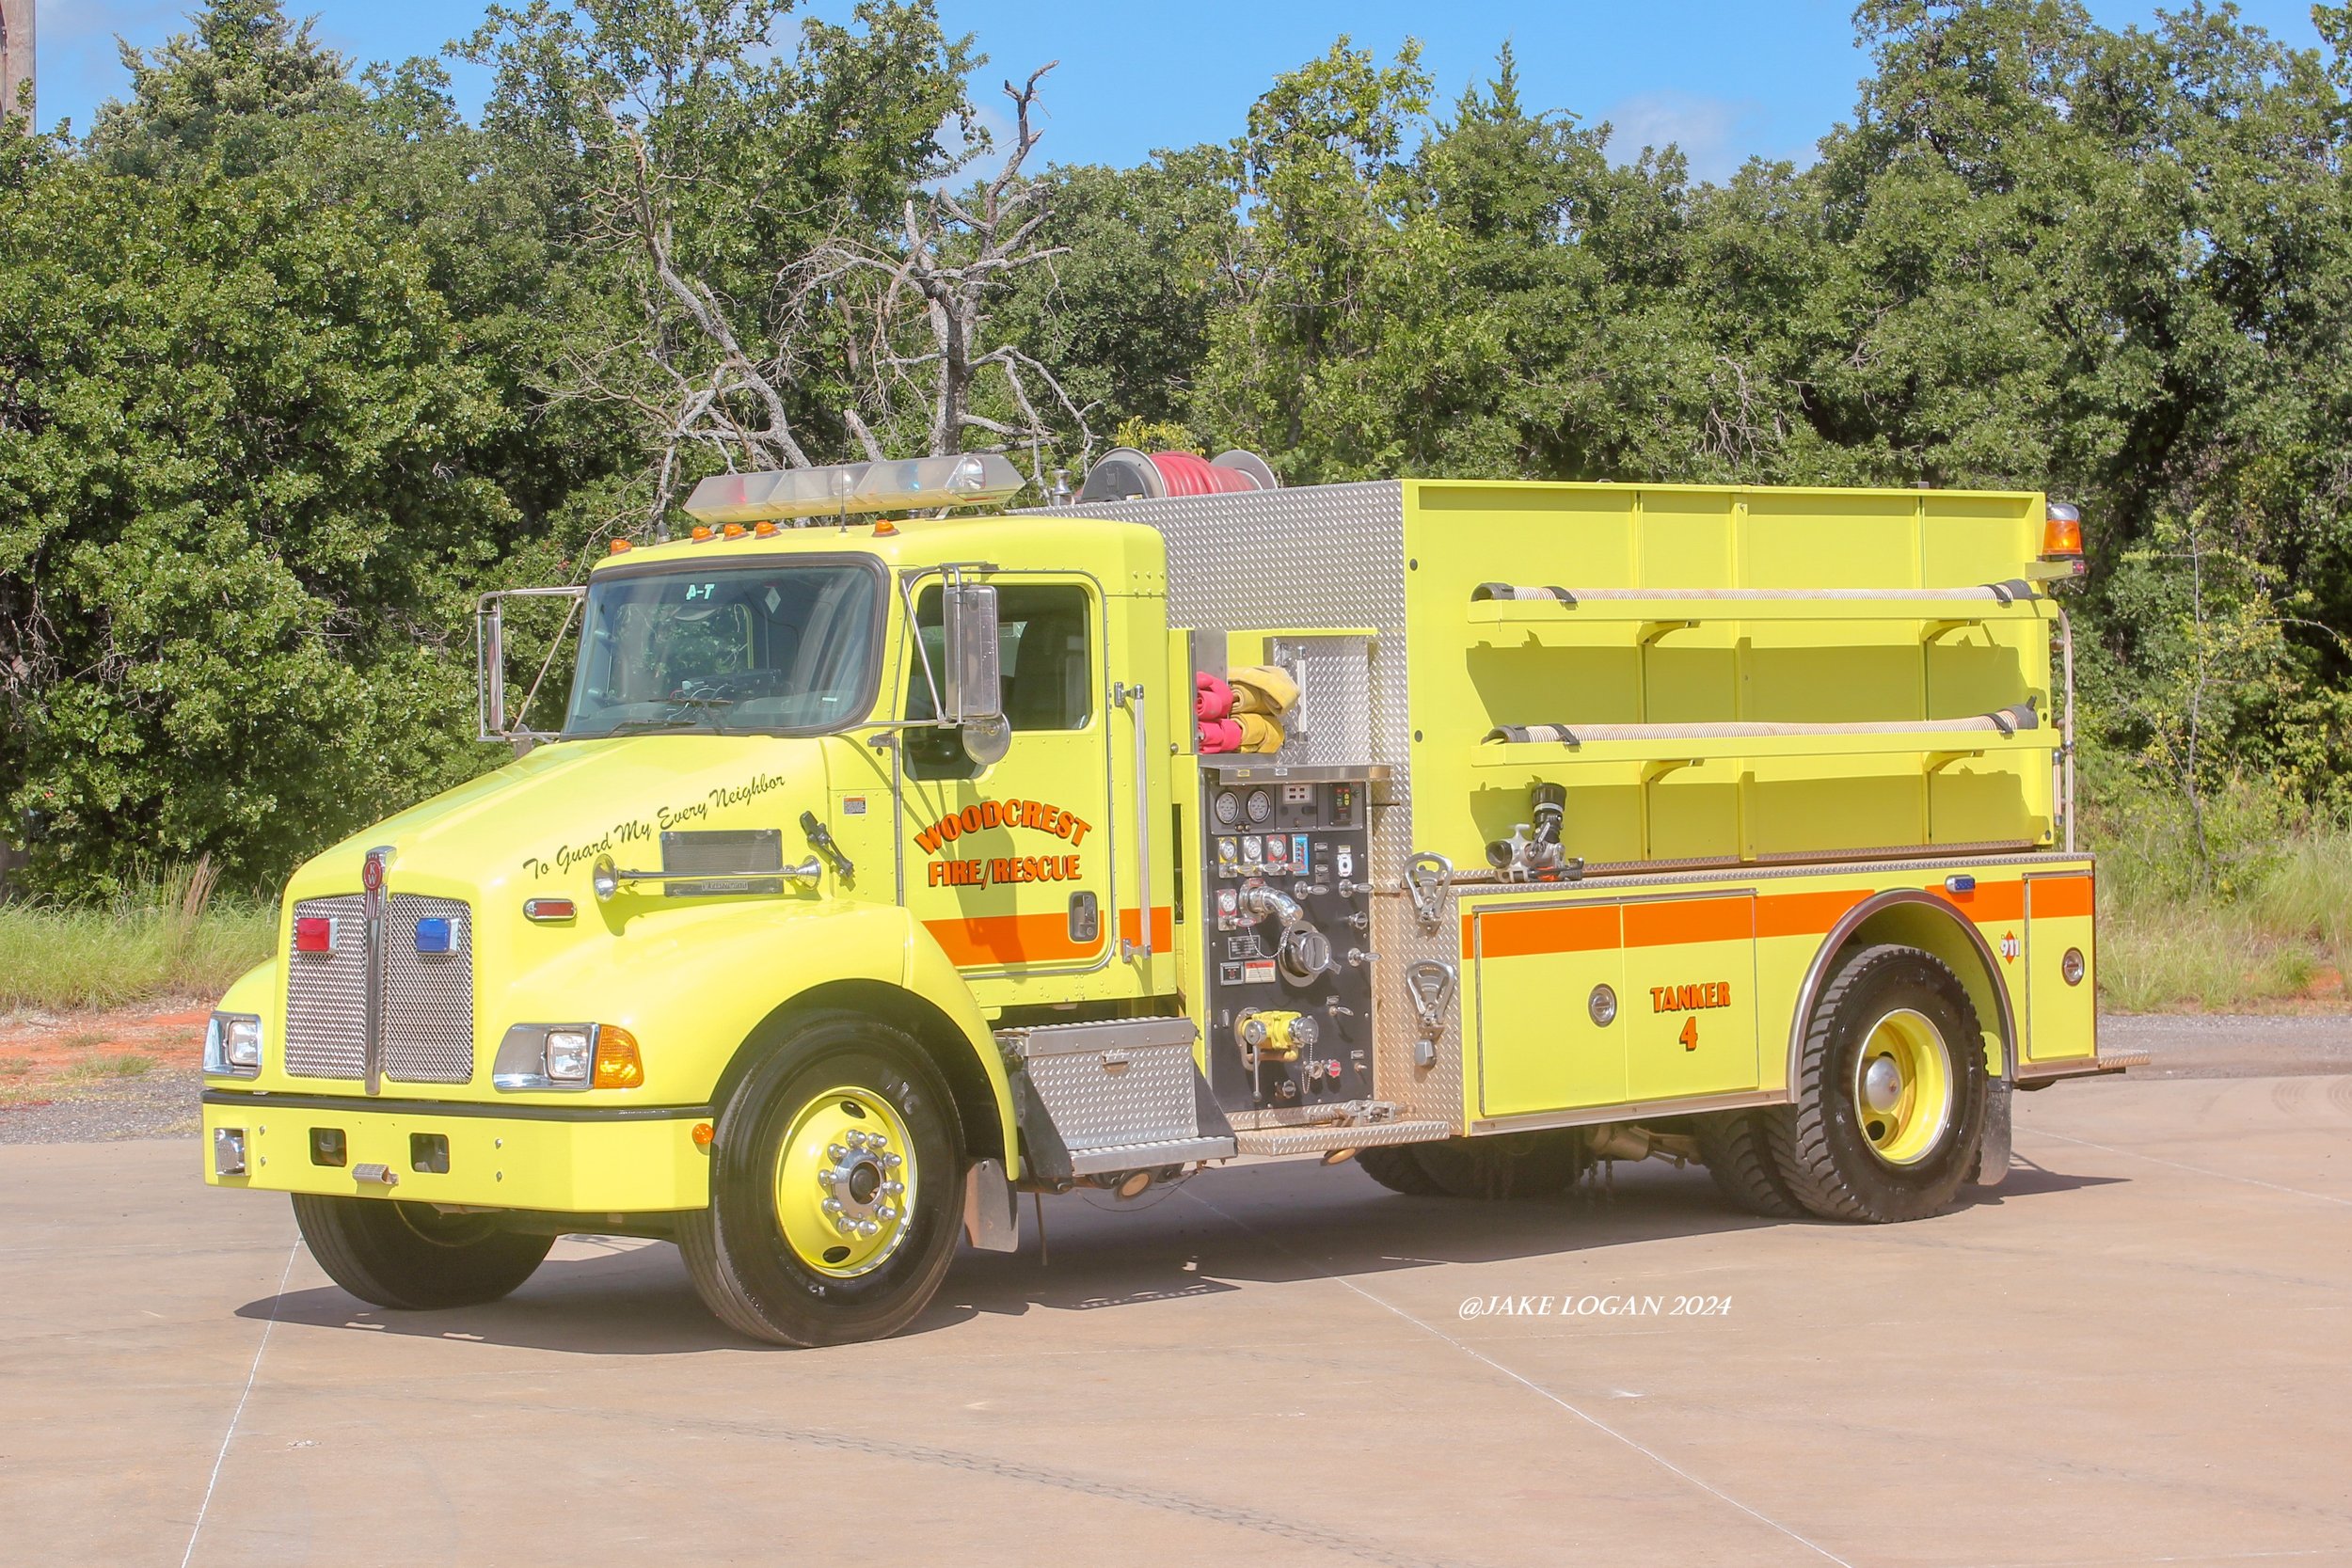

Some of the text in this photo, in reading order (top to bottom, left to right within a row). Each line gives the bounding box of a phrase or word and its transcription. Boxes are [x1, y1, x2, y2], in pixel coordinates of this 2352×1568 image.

[686, 583, 715, 600] A-T
[523, 773, 786, 879] To Guard My Every Neighbor
[914, 799, 1092, 855] WOODCREST
[929, 854, 1082, 890] FIRE/RESCUE
[1999, 939, 2021, 958] 911
[1650, 981, 1731, 1013] TANKER
[1679, 1016, 1698, 1052] 4
